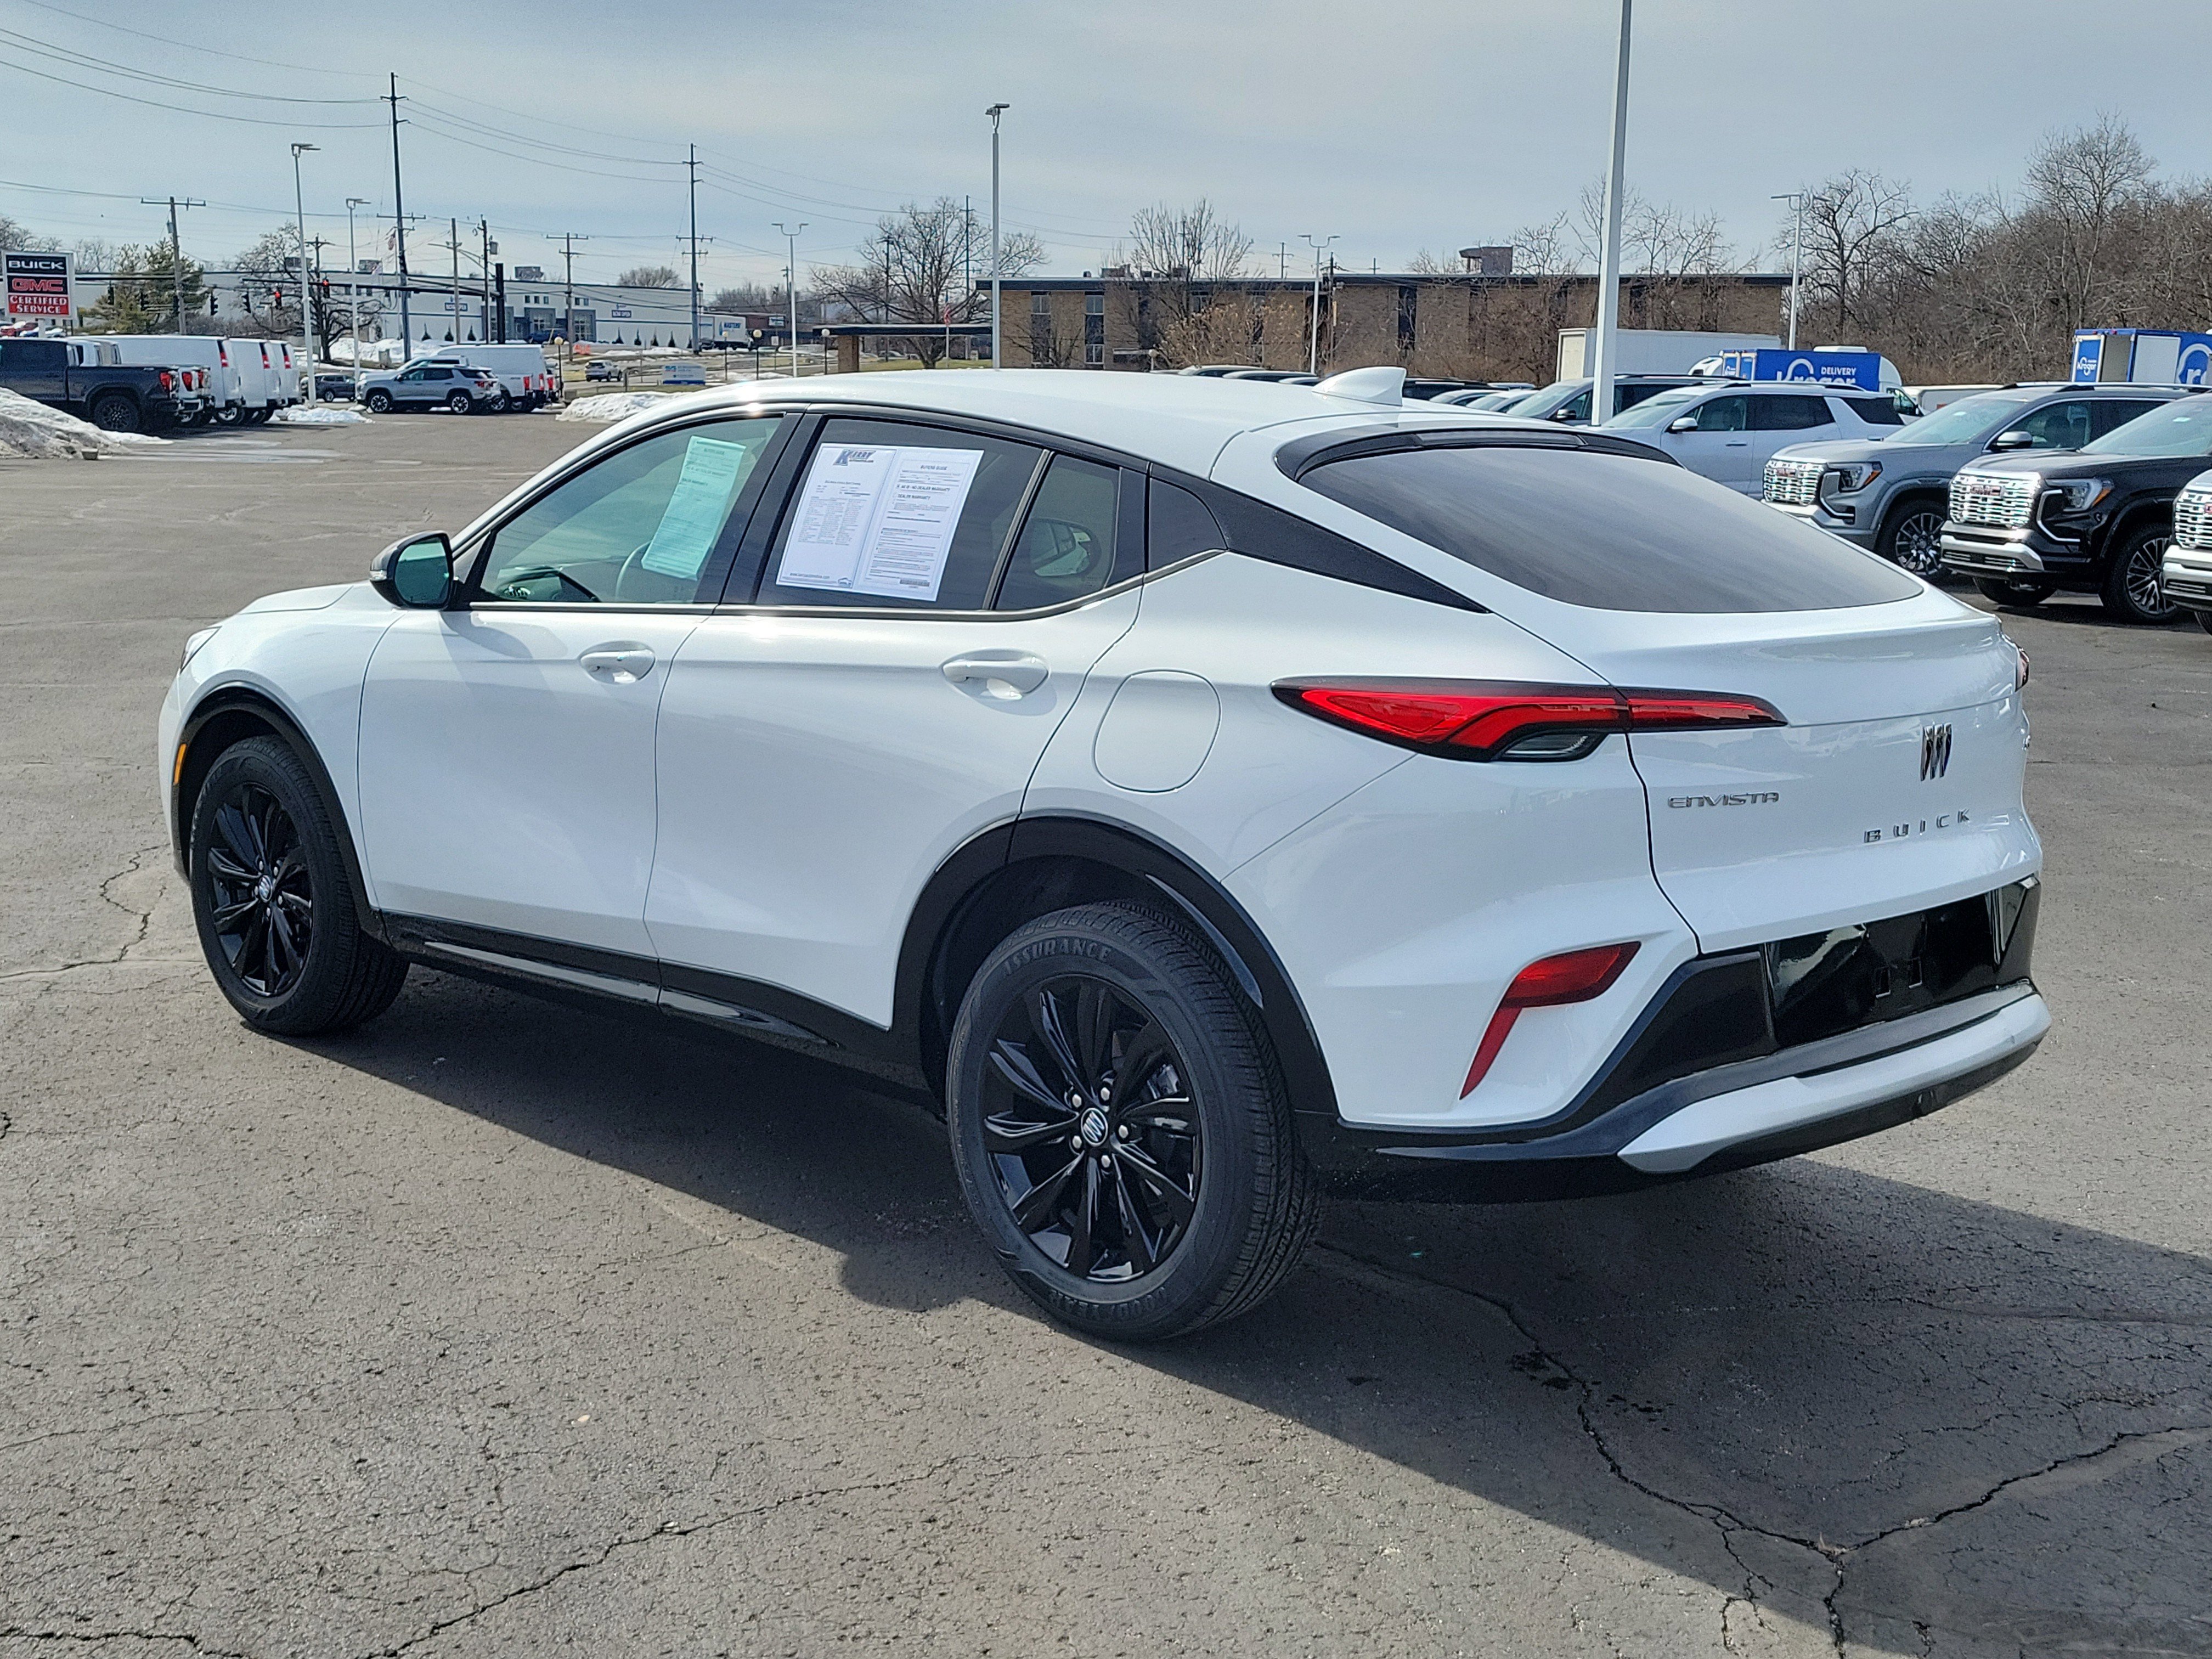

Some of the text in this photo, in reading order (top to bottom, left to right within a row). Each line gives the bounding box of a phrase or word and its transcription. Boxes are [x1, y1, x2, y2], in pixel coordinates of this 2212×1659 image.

[8, 261, 65, 269] BUICK
[12, 278, 63, 291] GMC
[10, 296, 66, 305] CERTIFIED
[16, 304, 61, 313] SERVICE
[1820, 366, 1857, 376] DELIVERY
[1970, 484, 2001, 496] GMC
[1667, 791, 1780, 809] ENVISTA
[1864, 808, 1970, 844] BUICK
